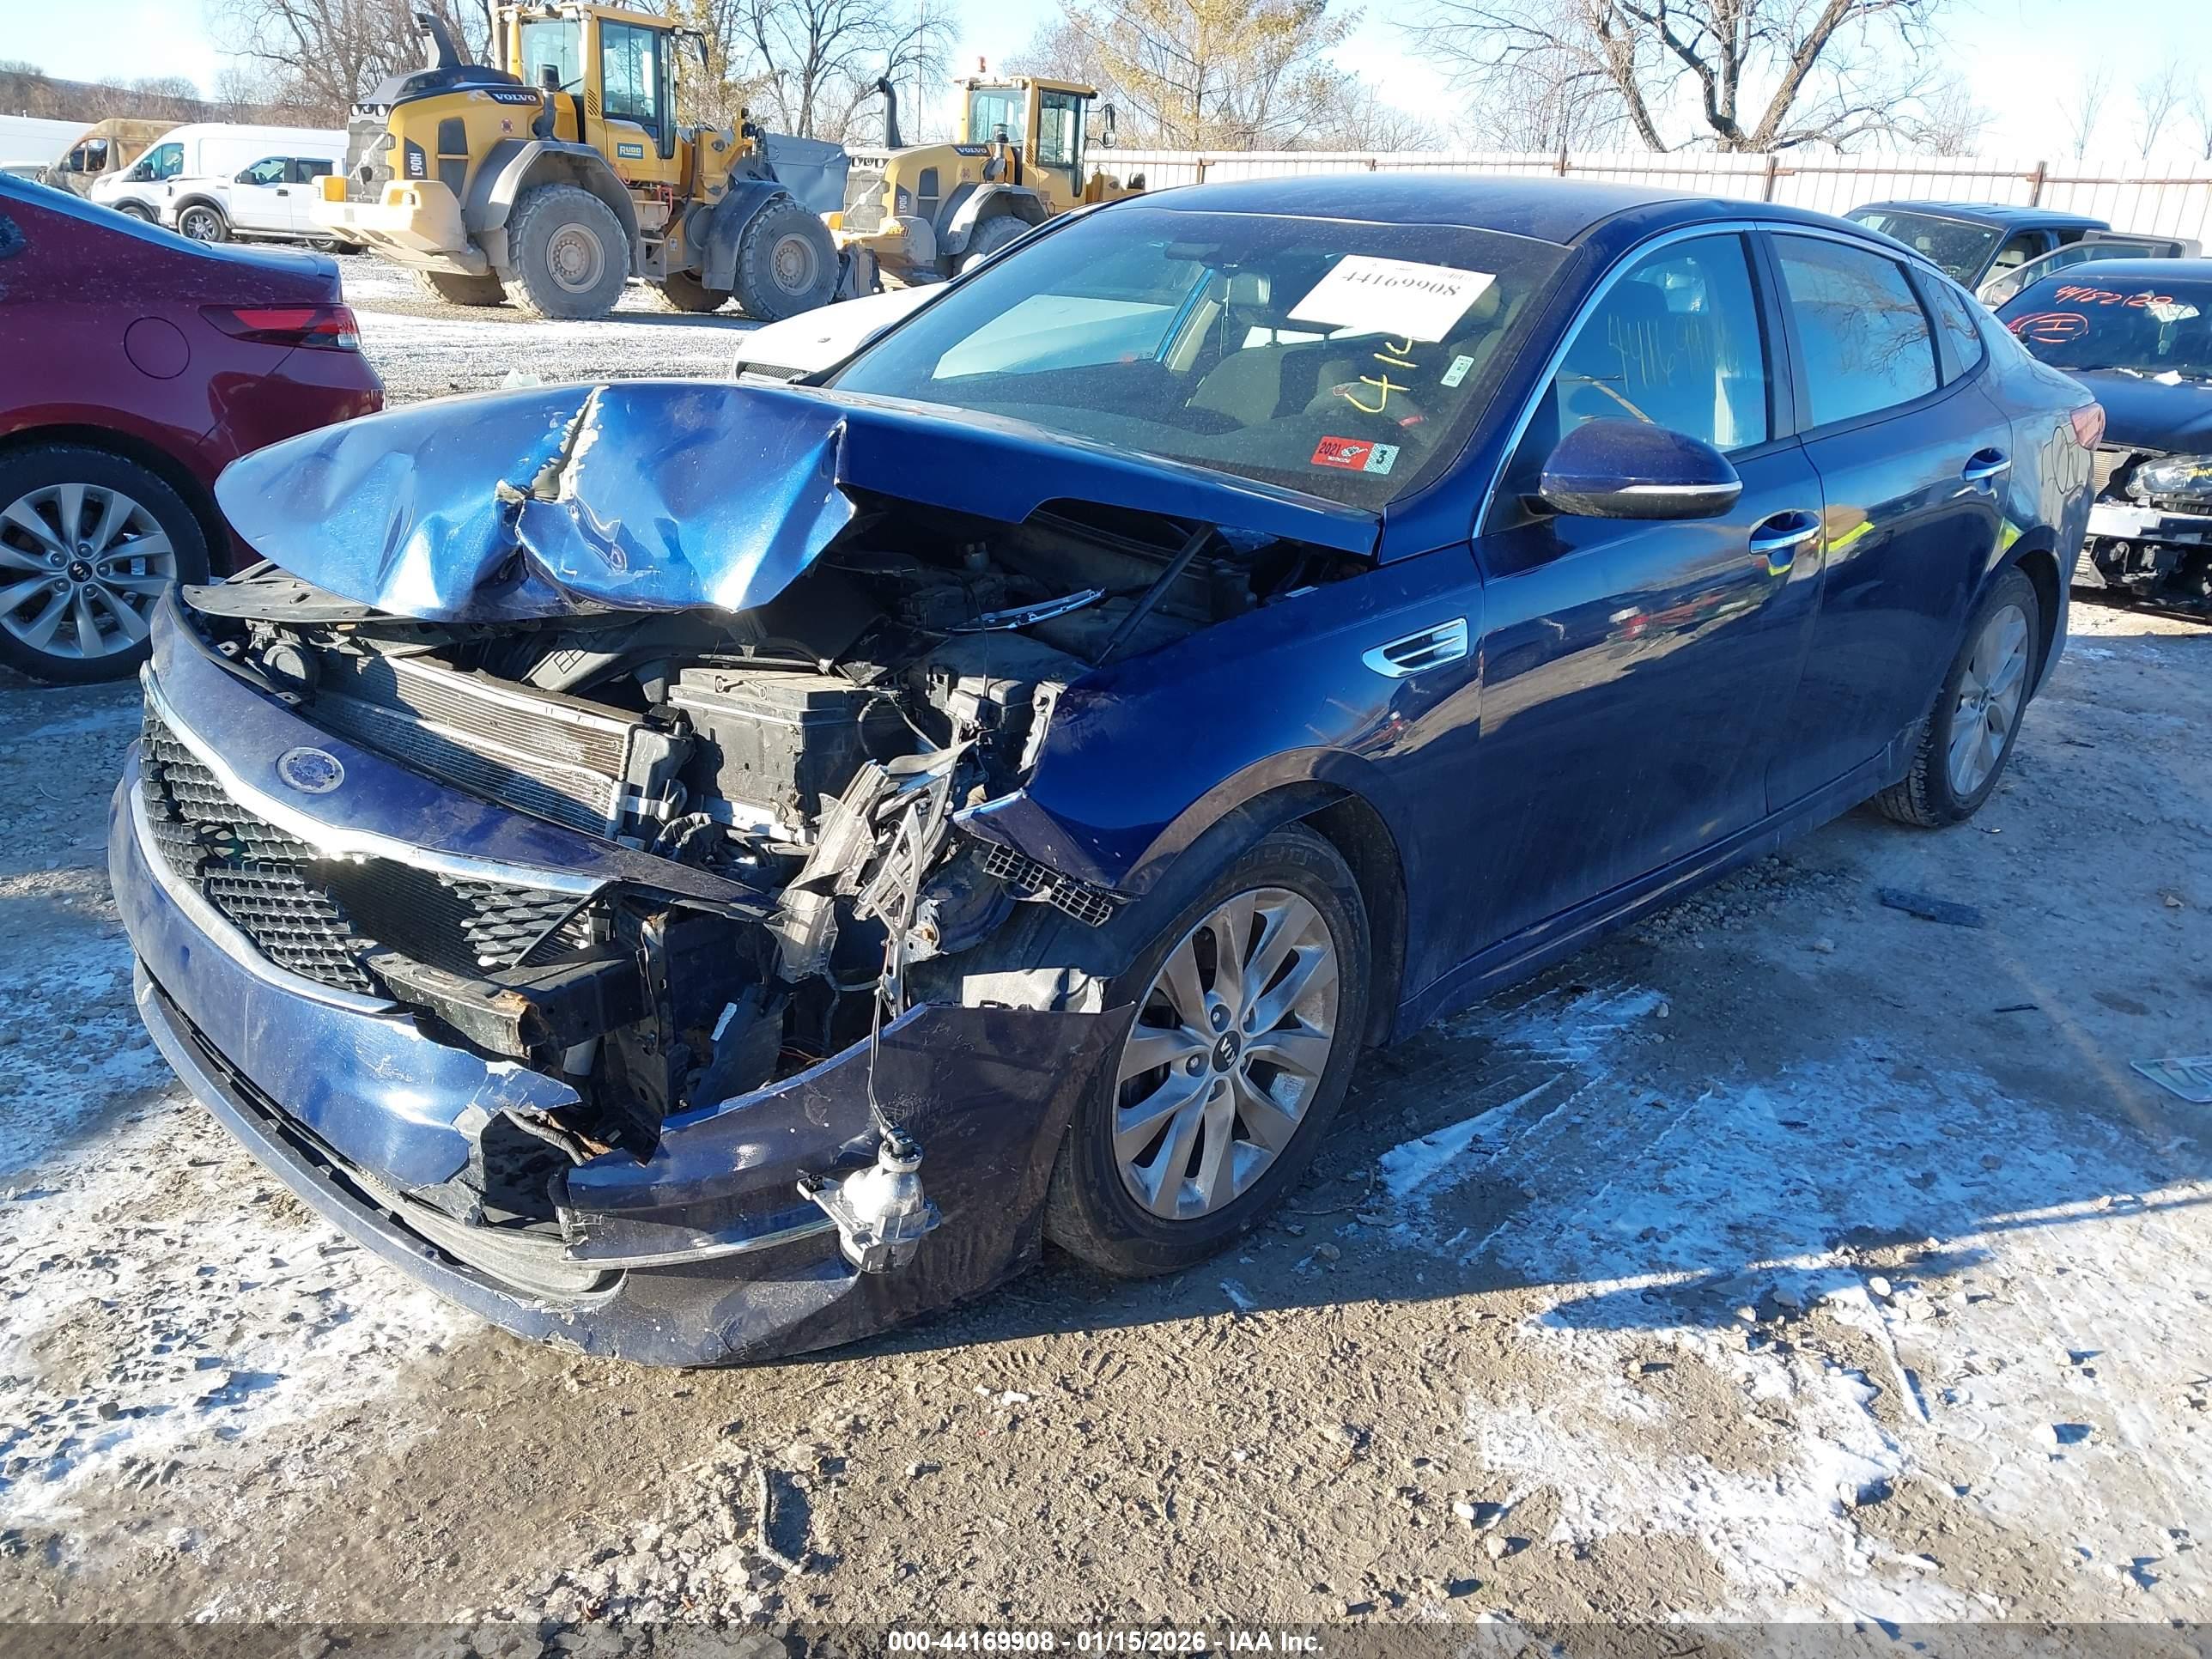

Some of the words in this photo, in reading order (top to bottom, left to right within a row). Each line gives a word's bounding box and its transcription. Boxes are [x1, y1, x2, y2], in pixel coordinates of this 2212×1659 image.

[493, 92, 537, 101] VOLVO
[410, 153, 423, 176] L90H
[1341, 270, 1461, 296] 44169908
[1318, 441, 1342, 456] 2021
[1376, 449, 1388, 465] 3
[73, 562, 90, 580] KIA
[1220, 1036, 1237, 1067] KIA
